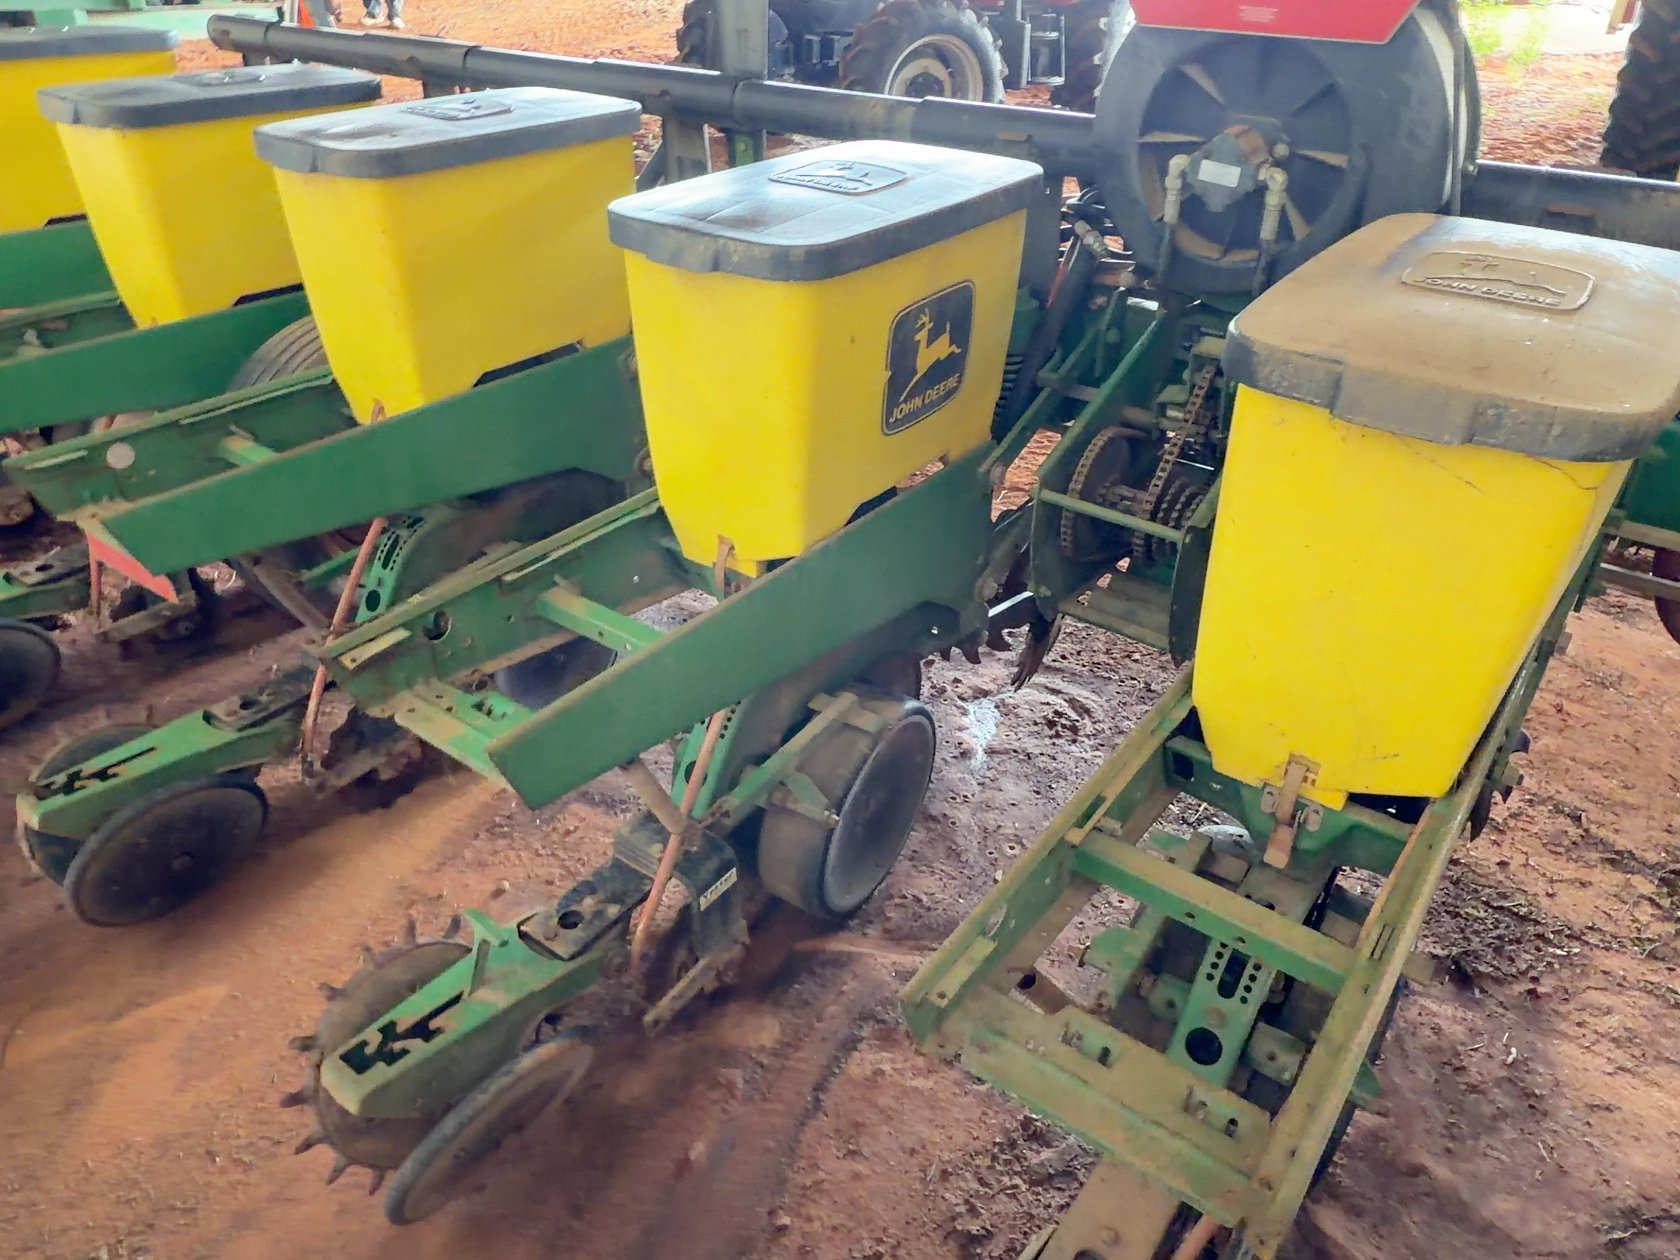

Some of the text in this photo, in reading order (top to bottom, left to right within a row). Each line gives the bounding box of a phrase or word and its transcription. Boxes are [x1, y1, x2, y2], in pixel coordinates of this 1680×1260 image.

[1481, 287, 1562, 307] DEERE
[889, 373, 960, 423] JOHN DEERE
